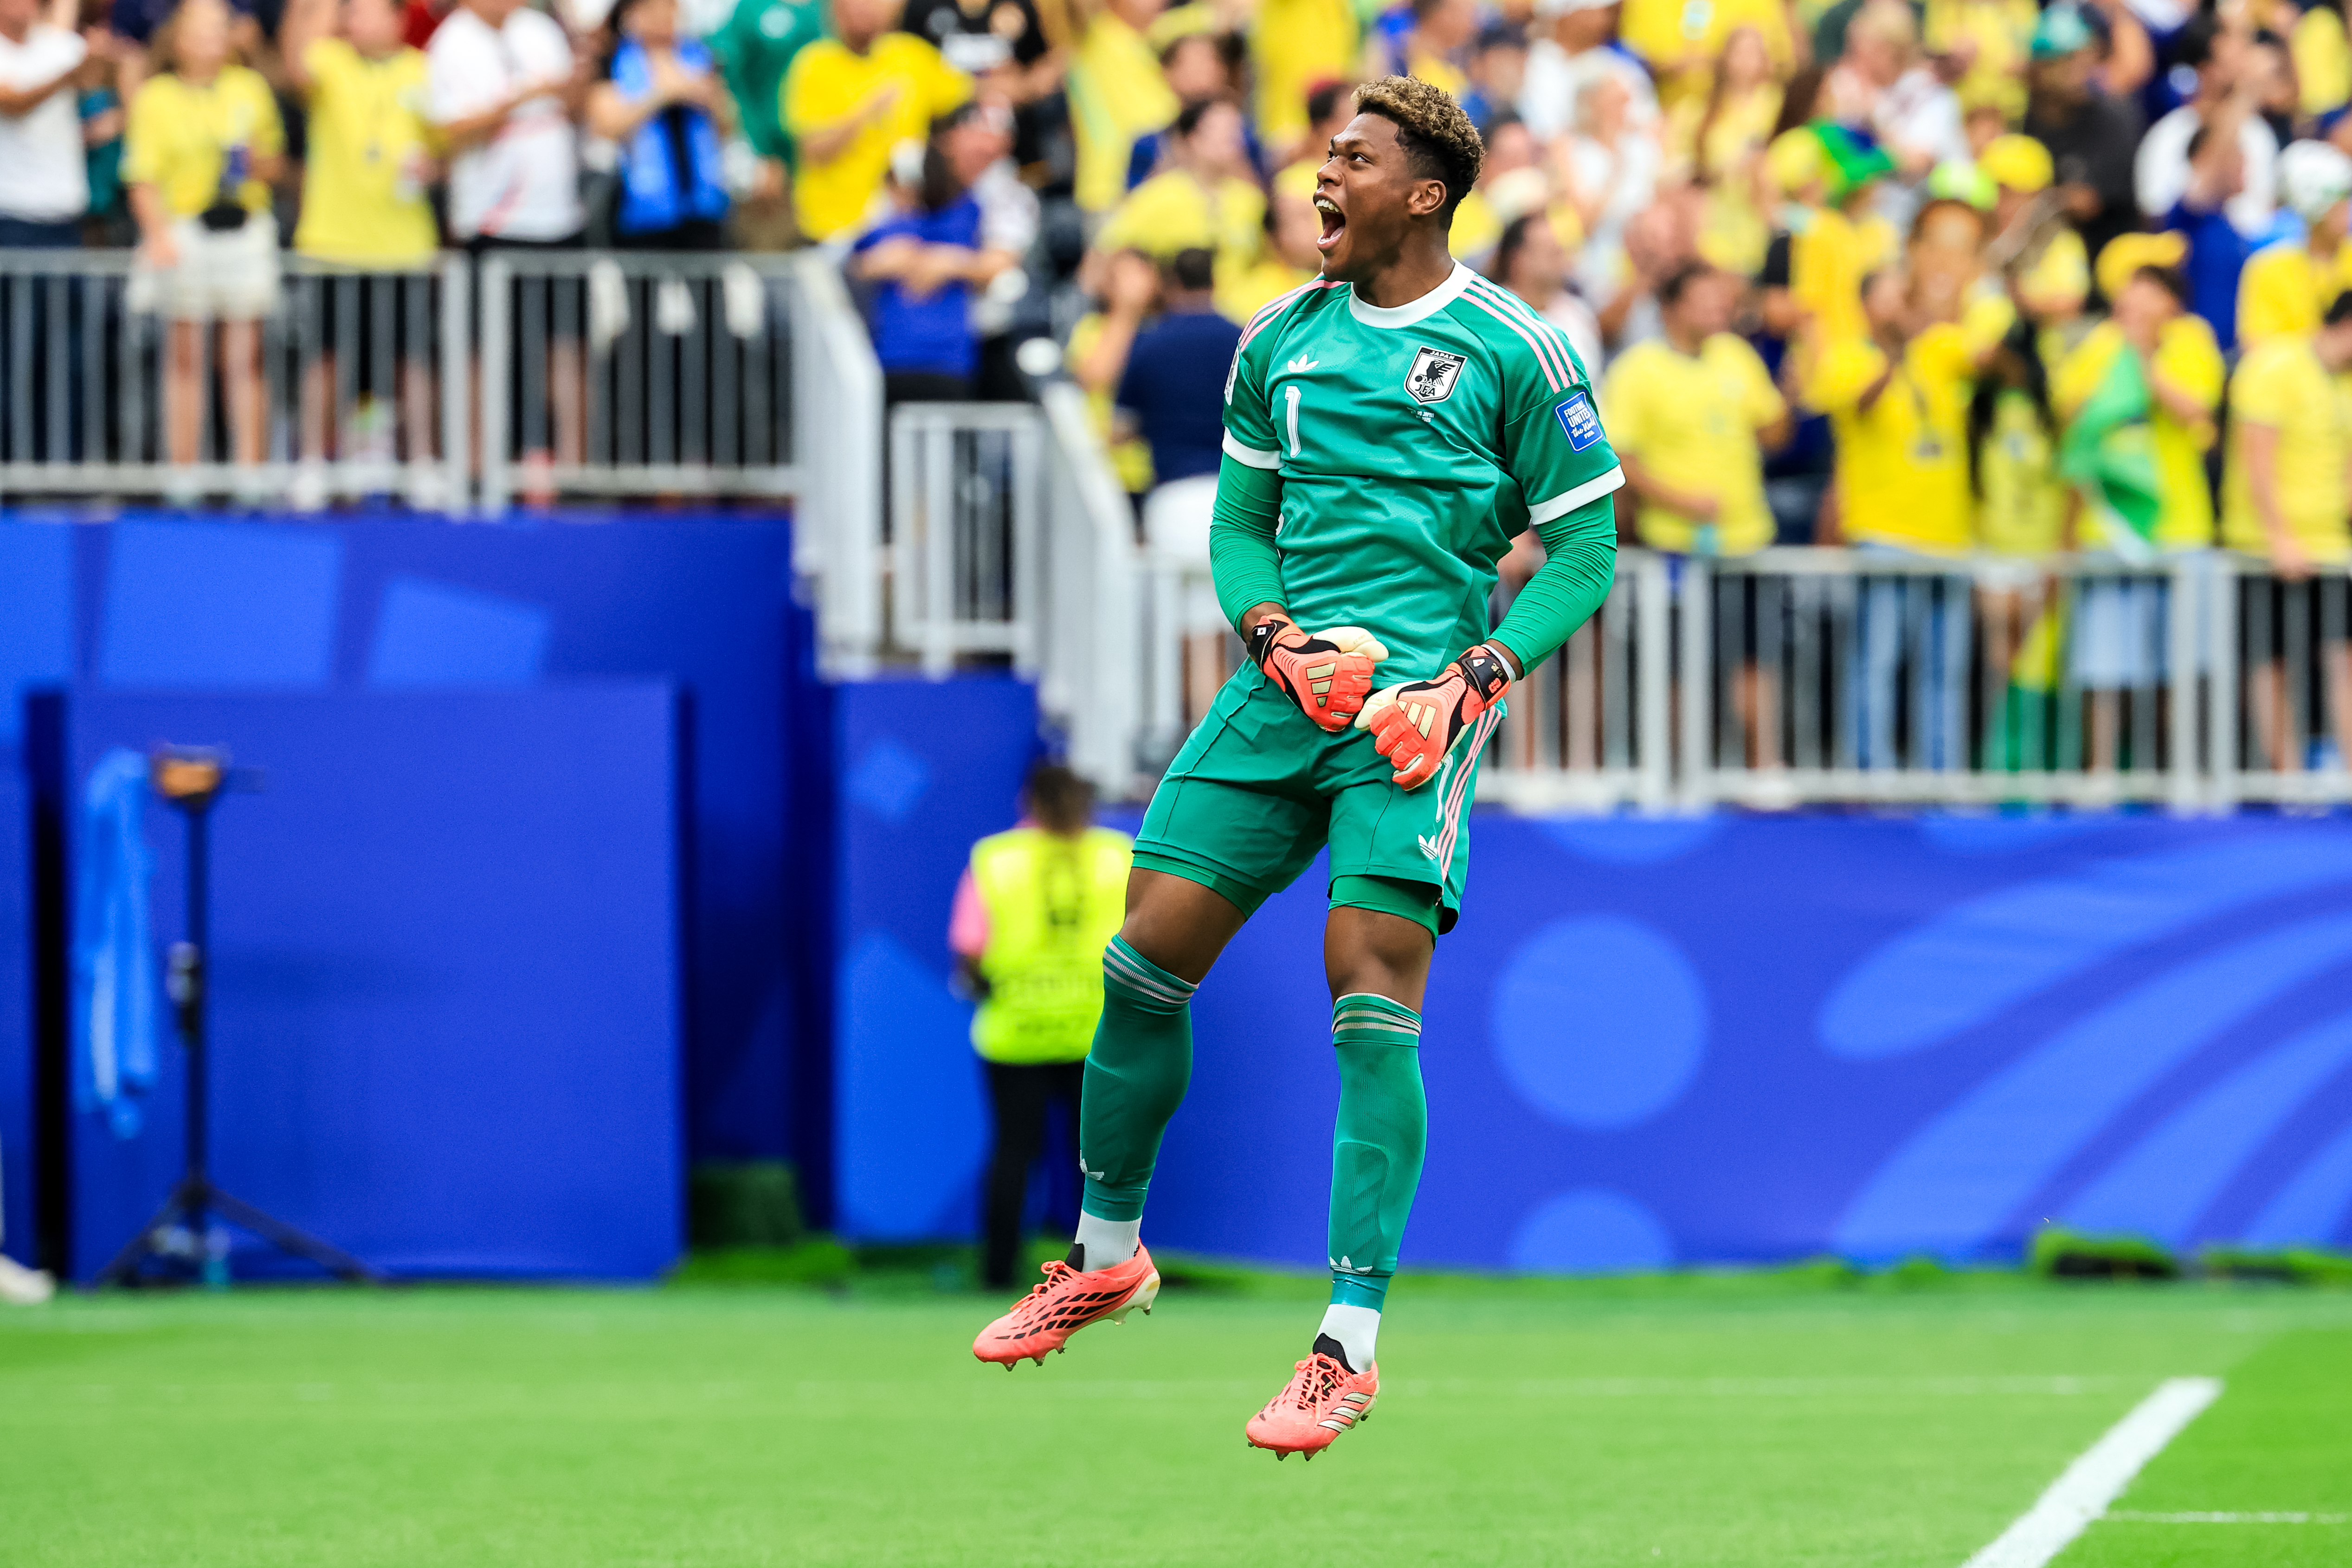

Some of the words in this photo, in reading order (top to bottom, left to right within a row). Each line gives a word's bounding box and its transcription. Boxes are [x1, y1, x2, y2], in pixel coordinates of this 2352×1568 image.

[1430, 351, 1455, 360] JAPAN
[1415, 384, 1435, 396] JFA
[1285, 386, 1302, 458] 1
[1567, 407, 1591, 427] UNITES
[1571, 426, 1584, 438] the
[1581, 416, 1597, 432] World
[1584, 430, 1595, 439] FIFA
